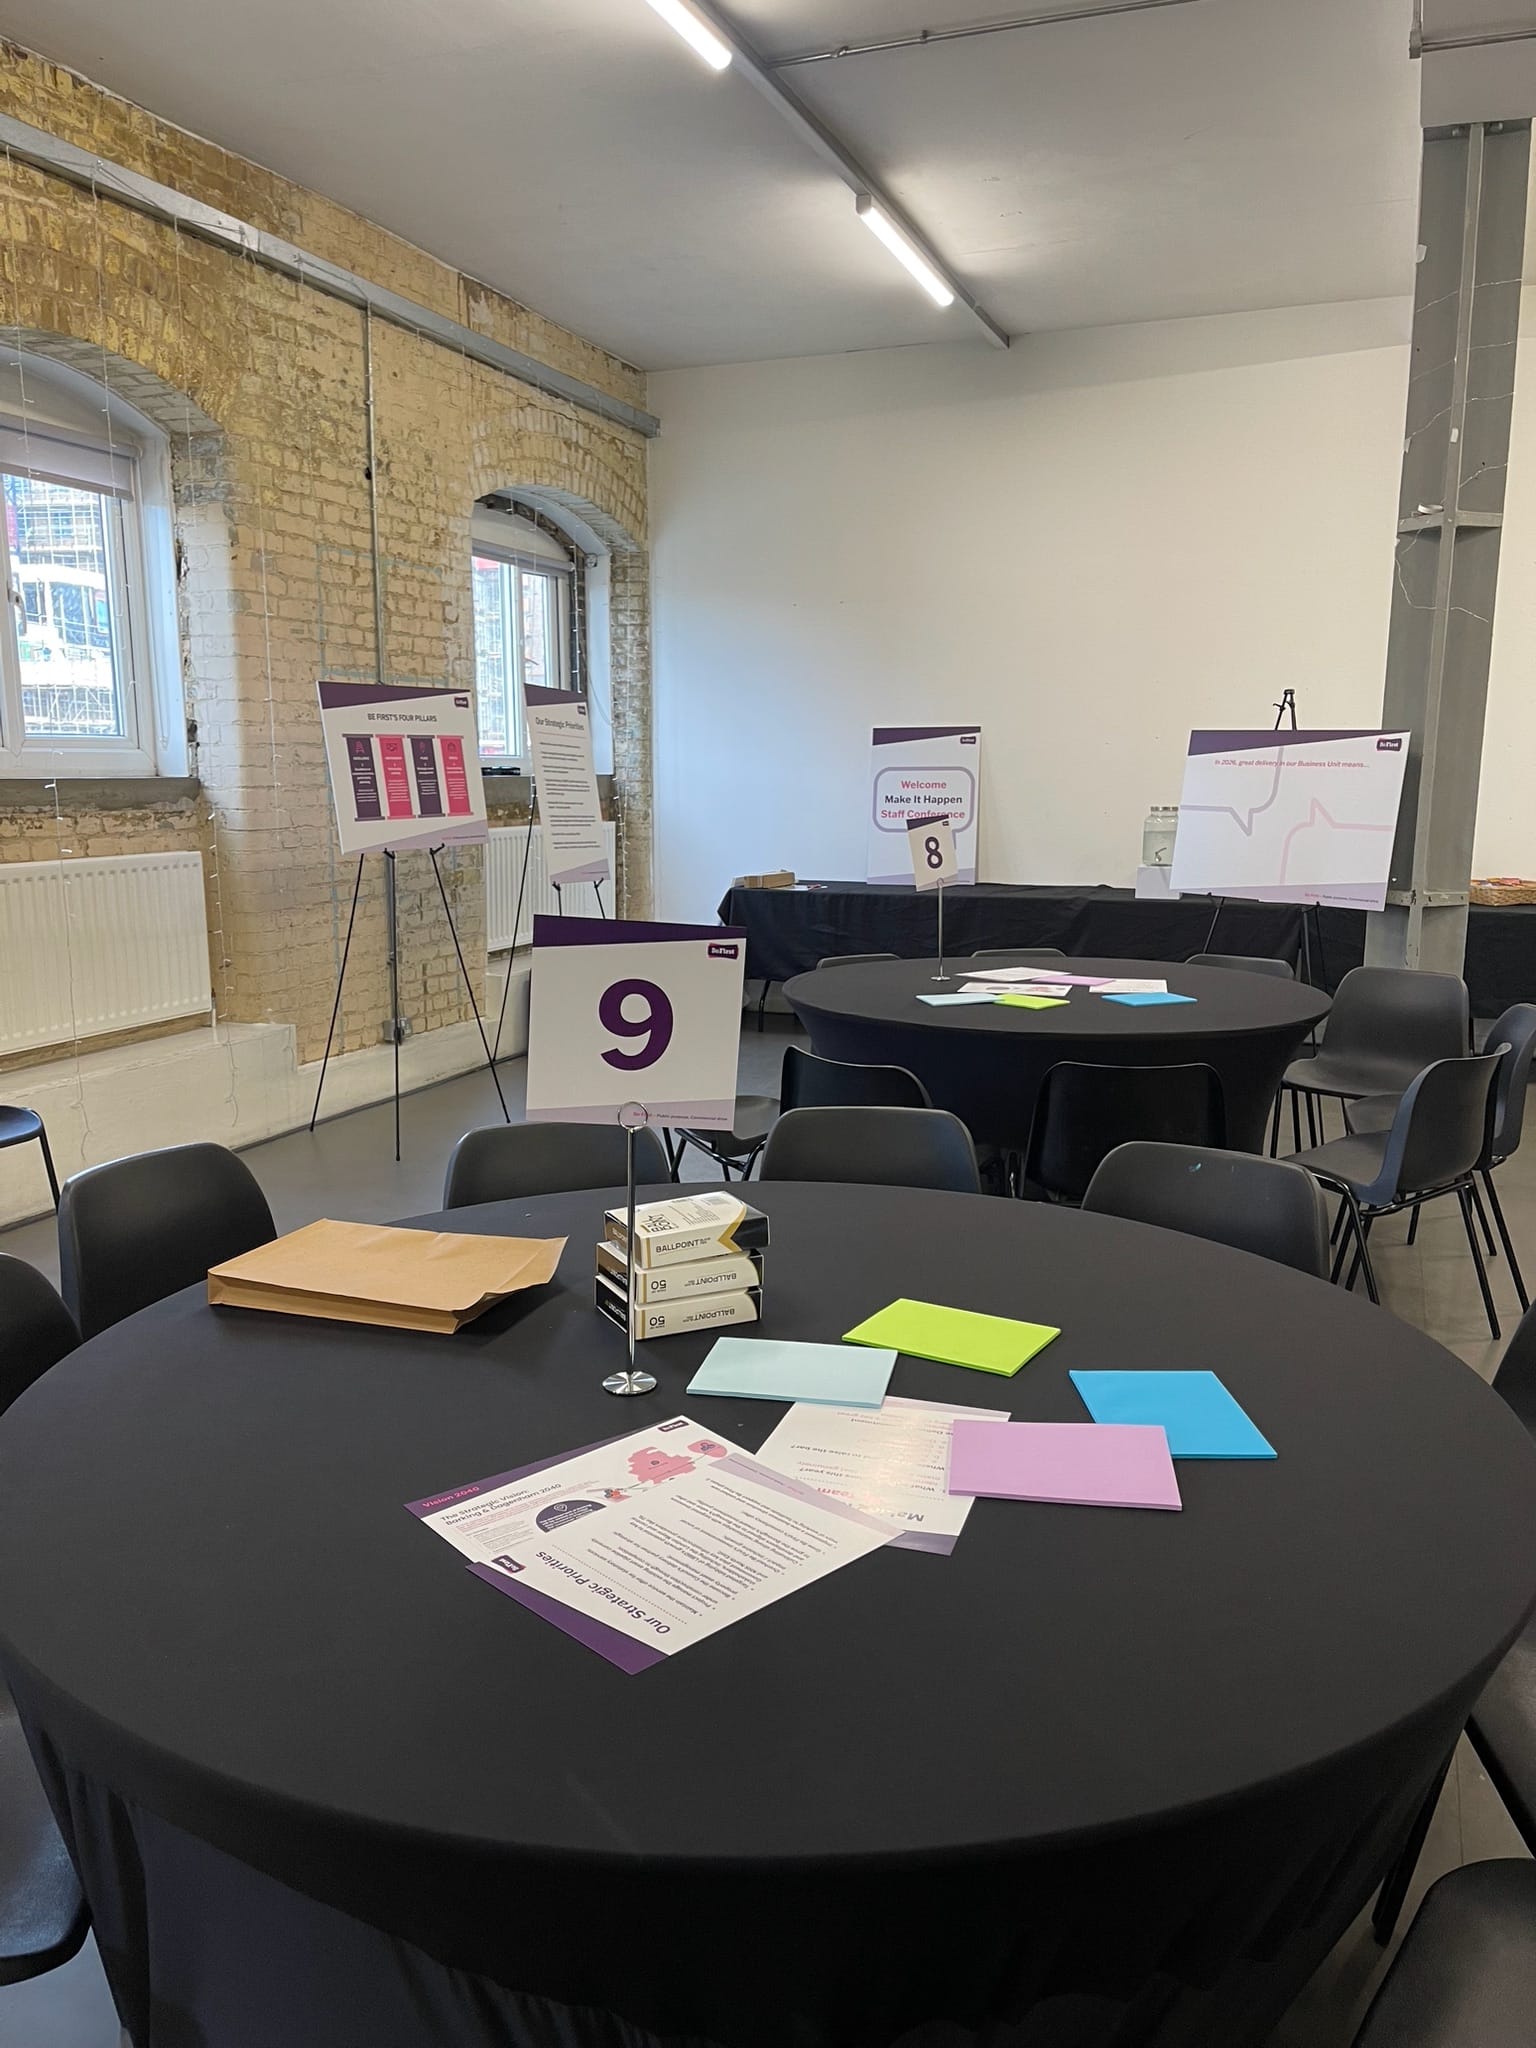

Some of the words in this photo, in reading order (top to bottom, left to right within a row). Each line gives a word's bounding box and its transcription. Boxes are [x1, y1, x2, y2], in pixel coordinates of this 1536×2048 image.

[536, 717, 544, 725] Our
[900, 780, 946, 789] Welcome
[884, 795, 911, 804] Make
[913, 795, 921, 804] It
[924, 795, 962, 805] Happen
[881, 810, 904, 818] Staff
[925, 836, 943, 869] 8
[599, 978, 673, 1071] 9
[656, 1238, 699, 1252] BALLPOINT
[651, 1280, 666, 1290] 50
[696, 1273, 736, 1285] BALLPOINT
[650, 1316, 665, 1326] 50
[694, 1308, 735, 1321] BALLPOINT
[422, 1493, 454, 1508] Vision
[454, 1486, 480, 1499] 2040
[440, 1511, 458, 1522] The
[458, 1498, 500, 1516] Strategic
[446, 1510, 482, 1526] Barking
[490, 1491, 540, 1512] Dagenham
[540, 1484, 562, 1494] 2040
[536, 1551, 589, 1584] Priorities
[588, 1582, 645, 1618] Strategic
[644, 1617, 670, 1633] Our
